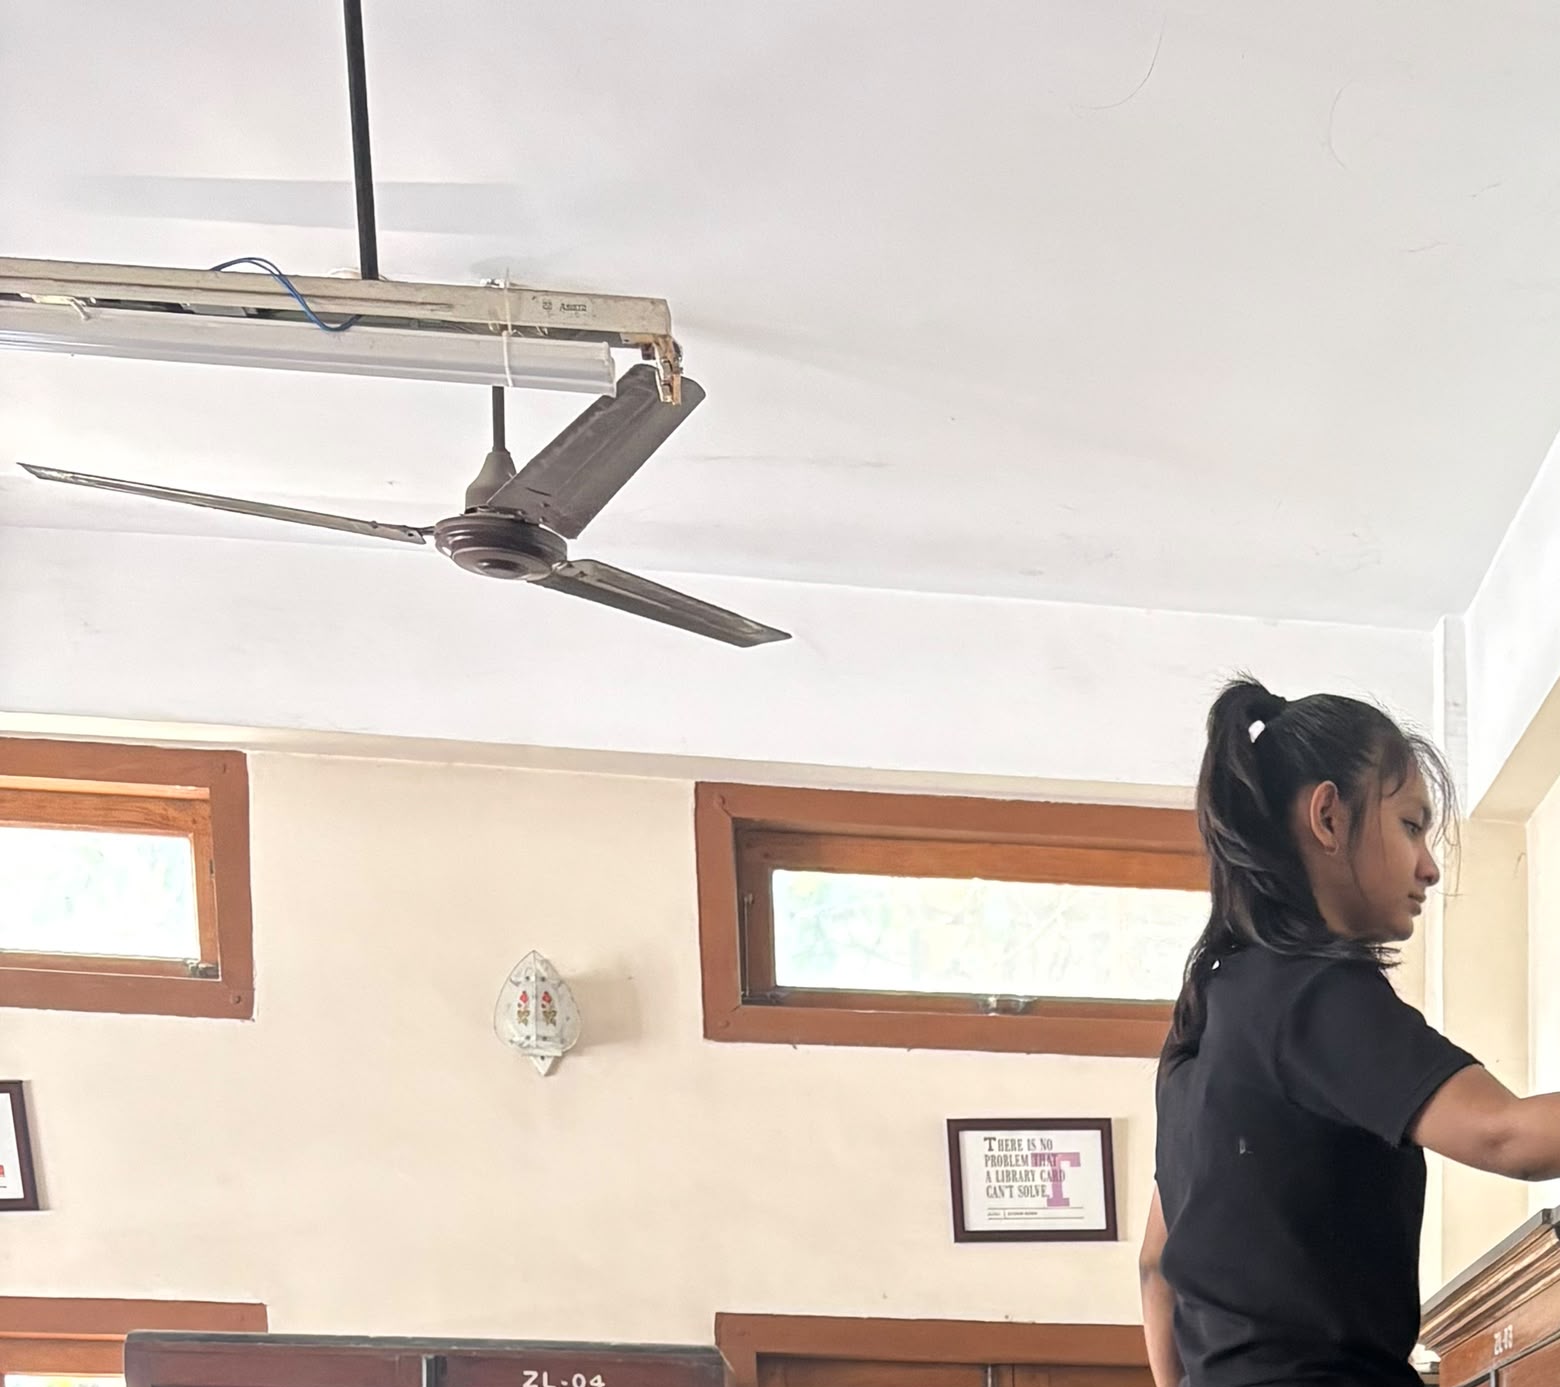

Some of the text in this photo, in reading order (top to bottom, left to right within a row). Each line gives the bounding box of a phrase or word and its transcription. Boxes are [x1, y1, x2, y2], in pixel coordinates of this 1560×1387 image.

[984, 1137, 1053, 1152] THERE IS NO
[984, 1153, 1058, 1168] PROBLEM THAT
[985, 1169, 1065, 1183] A LIBRARY CARD
[985, 1184, 1015, 1199] CAN'T
